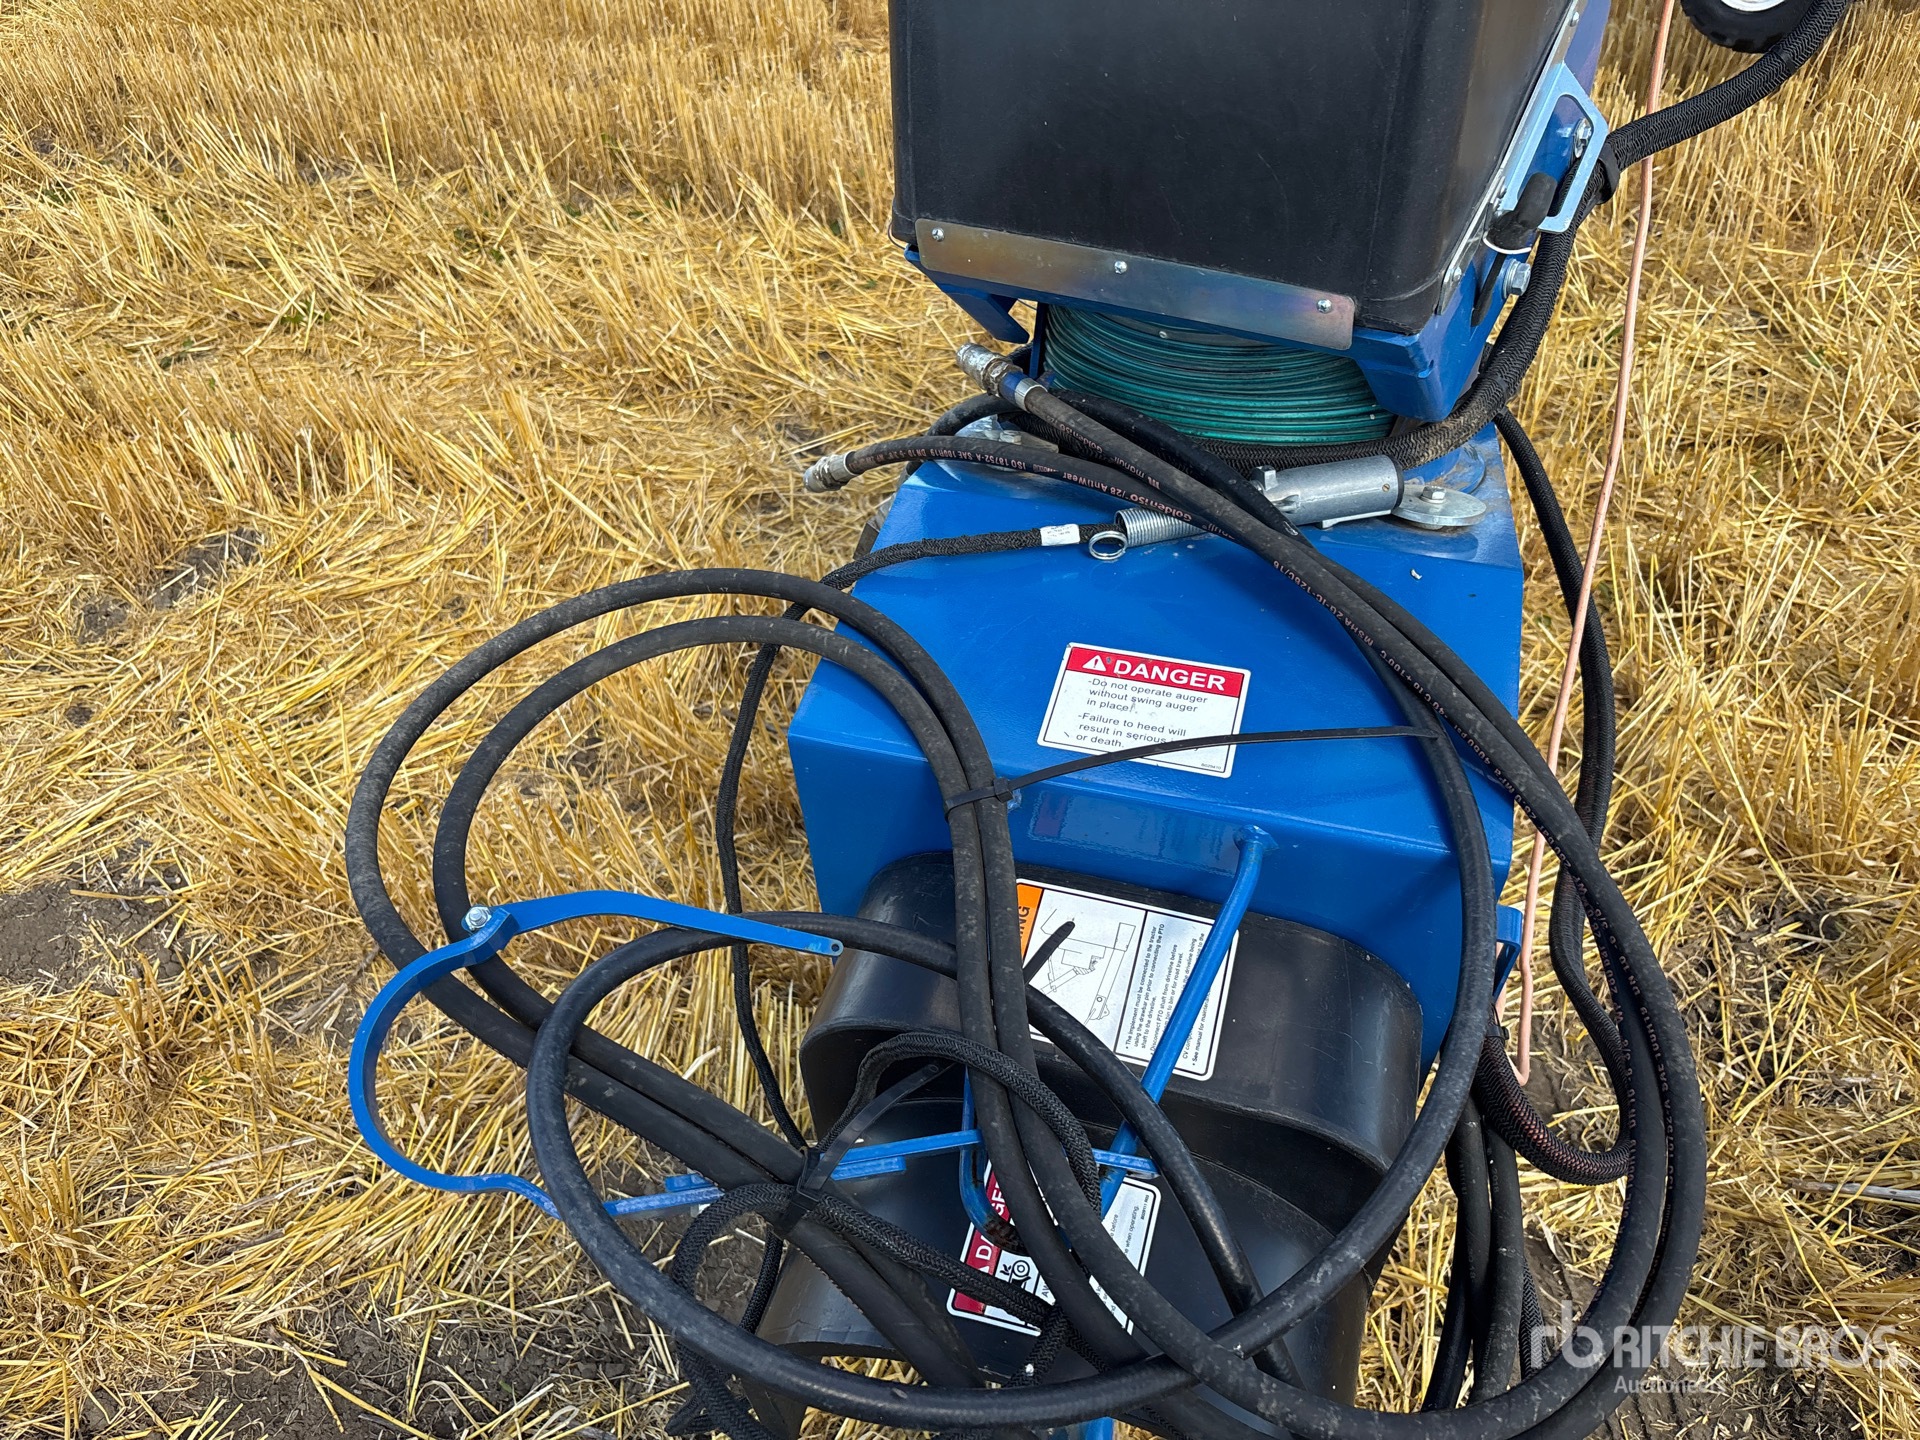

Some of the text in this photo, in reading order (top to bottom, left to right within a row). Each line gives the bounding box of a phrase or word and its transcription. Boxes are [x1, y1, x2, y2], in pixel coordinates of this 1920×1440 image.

[930, 448, 956, 458] 100R19
[958, 450, 973, 459] SAE
[976, 453, 1009, 466] 18752-A
[1011, 460, 1026, 470] ISO
[1062, 471, 1108, 493] AntiWear
[1344, 617, 1374, 647] MSHA
[1113, 659, 1225, 691] DANGER
[1086, 697, 1096, 707] in
[1089, 688, 1198, 714] without swing auger
[1110, 681, 1128, 691] not
[1130, 685, 1172, 698] operate
[1175, 692, 1208, 705] auger
[1078, 712, 1186, 737] -Failure to heed will
[1079, 723, 1110, 736] result
[1112, 727, 1122, 737] in
[1126, 731, 1166, 744] serious
[1076, 734, 1125, 748] or death.
[1190, 938, 1198, 955] being
[1140, 959, 1149, 986] connected
[1134, 1032, 1142, 1047] using
[1139, 1002, 1148, 1023] drawbar
[1151, 945, 1162, 972] connecting
[1138, 986, 1143, 994] be
[1150, 1022, 1160, 1051] Disconnect
[1166, 961, 1174, 982] driveline
[1170, 944, 1178, 961] before
[1148, 995, 1157, 1019] driveline.
[1129, 1008, 1139, 1035] implement
[1195, 1031, 1203, 1051] manual
[1183, 1051, 1188, 1059] CV
[975, 1184, 1006, 1261] DGE
[1110, 1214, 1119, 1232] before
[1124, 1232, 1132, 1248] when
[1128, 1205, 1140, 1232] operating.
